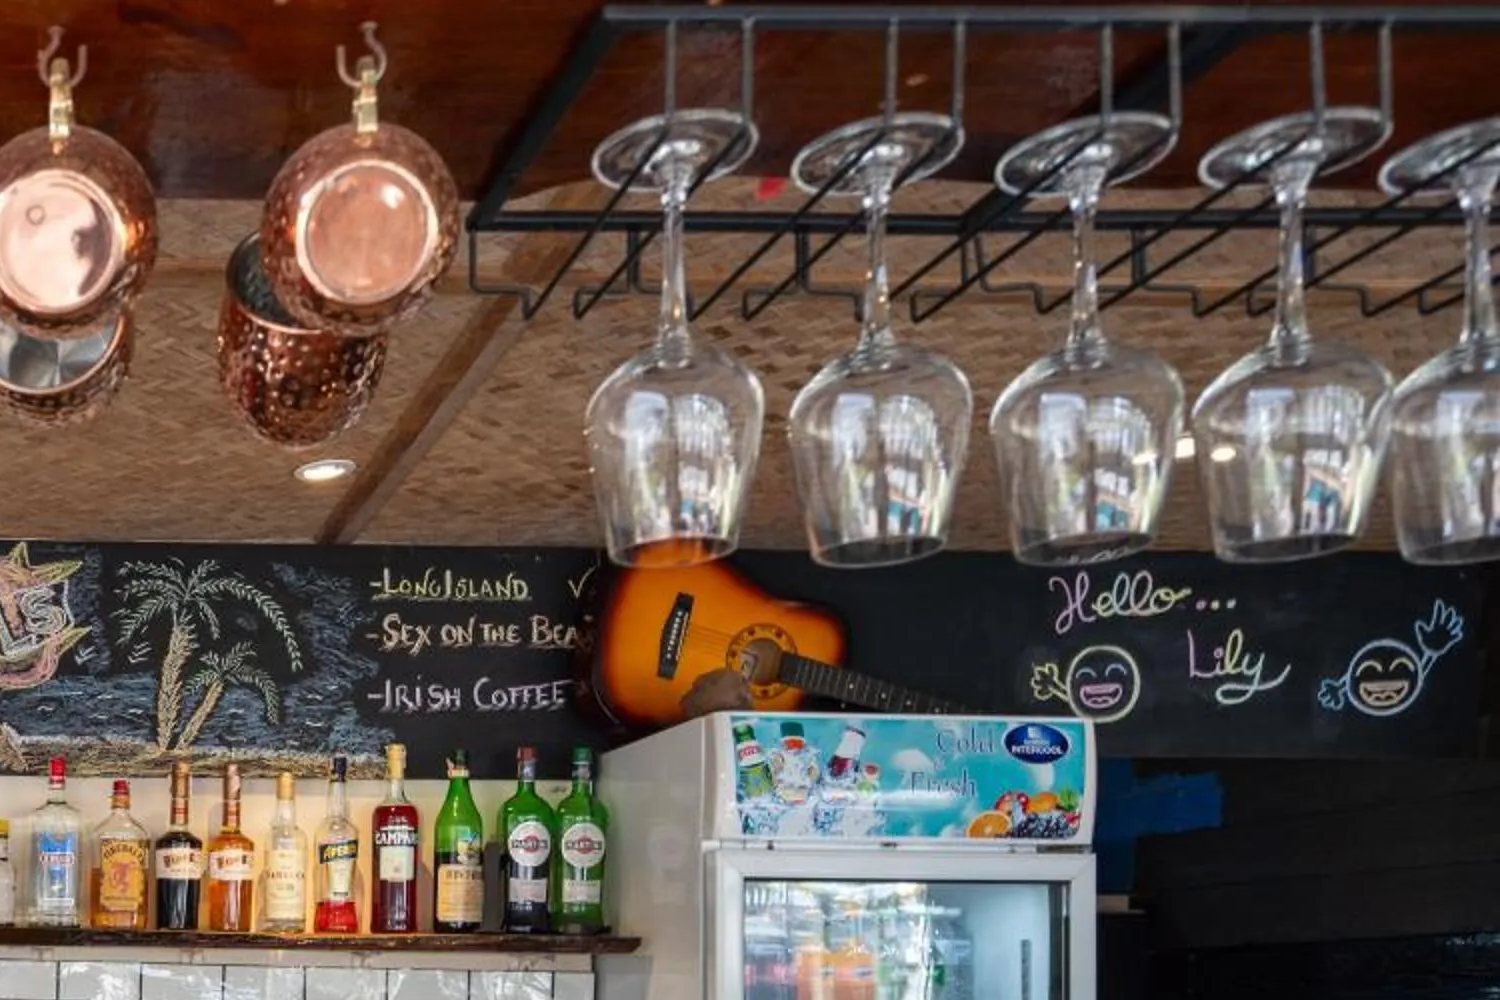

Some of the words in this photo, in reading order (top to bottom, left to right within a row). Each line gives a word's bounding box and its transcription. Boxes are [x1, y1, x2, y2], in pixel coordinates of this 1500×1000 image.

[529, 614, 579, 647] BEA
[1187, 630, 1291, 705] Lily
[936, 727, 994, 755] Cold
[909, 770, 979, 799] Fresh
[375, 831, 418, 845] CAMPA
